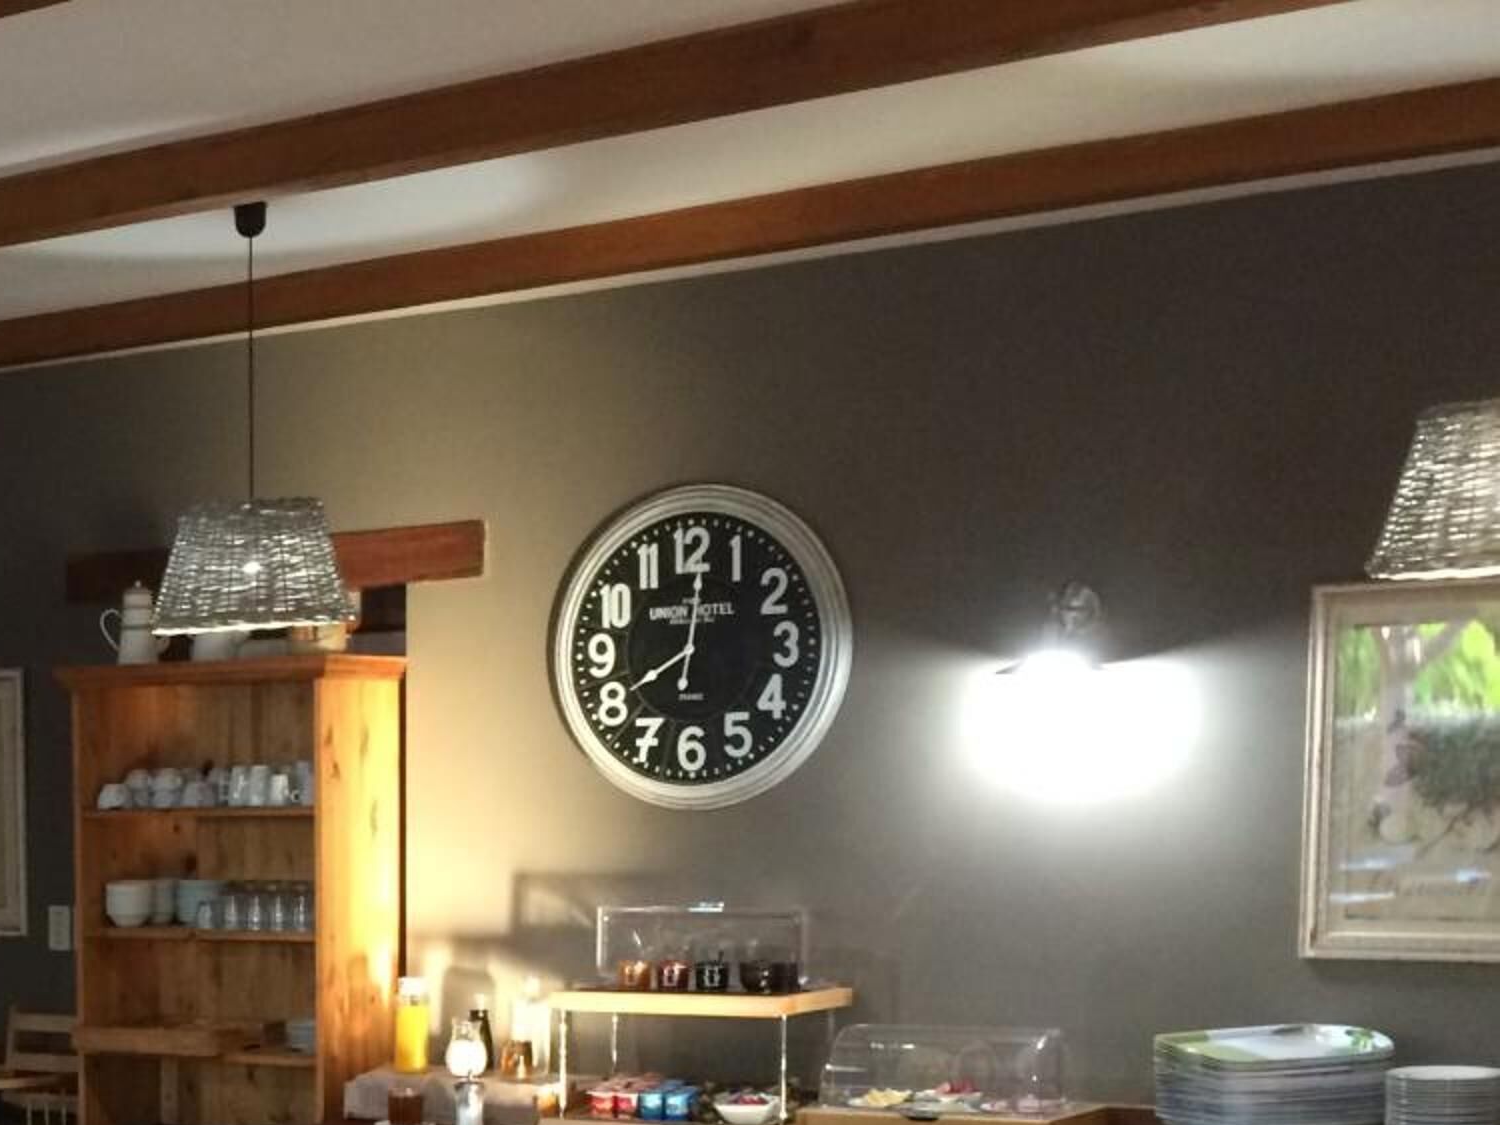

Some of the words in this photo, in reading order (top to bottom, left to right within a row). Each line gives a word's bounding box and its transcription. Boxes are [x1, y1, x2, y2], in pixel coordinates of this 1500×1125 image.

[637, 543, 659, 591] 11
[674, 526, 710, 574] 12
[729, 534, 741, 582] 1
[599, 582, 631, 629] 10
[649, 605, 688, 621] UNION
[760, 567, 788, 615] 2
[587, 632, 616, 679] 9
[773, 621, 799, 668] 3
[598, 681, 628, 727] 8
[756, 673, 787, 720] 4
[635, 717, 664, 763] 7
[677, 726, 707, 772] 6
[724, 711, 754, 758] 5
